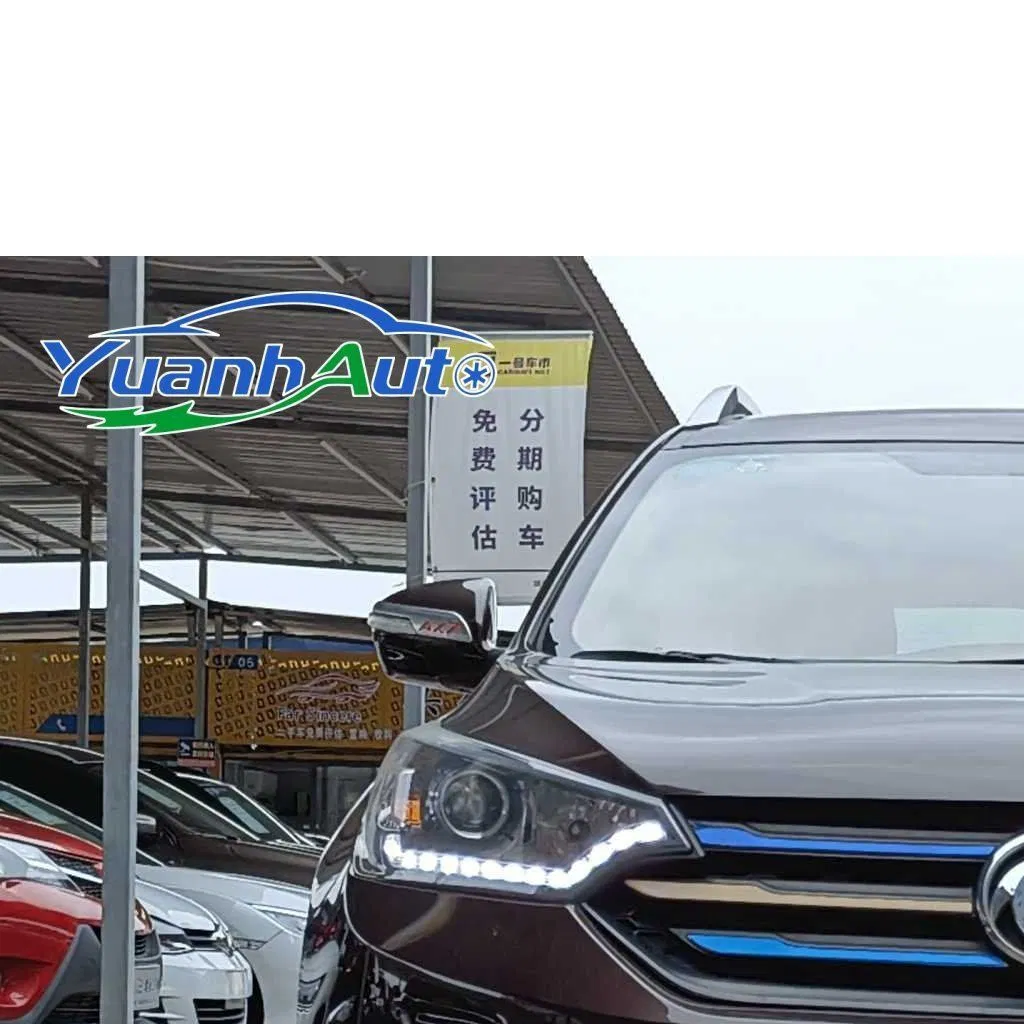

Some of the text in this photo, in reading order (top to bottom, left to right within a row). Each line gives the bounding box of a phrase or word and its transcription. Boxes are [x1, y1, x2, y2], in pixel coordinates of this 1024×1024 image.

[470, 409, 497, 551] 免费评估
[517, 408, 545, 550] 分期购车
